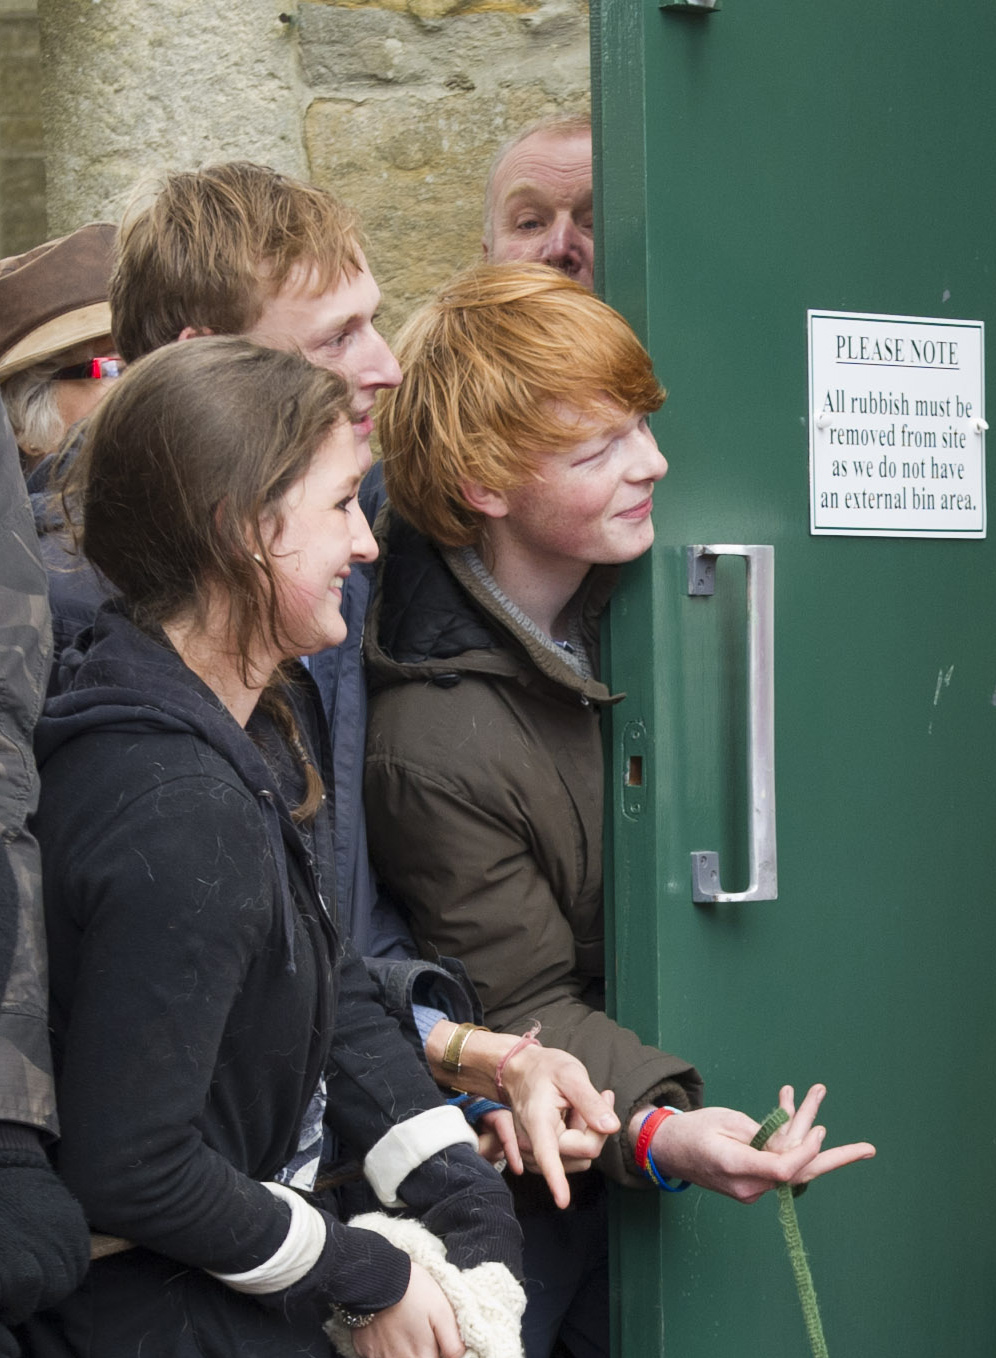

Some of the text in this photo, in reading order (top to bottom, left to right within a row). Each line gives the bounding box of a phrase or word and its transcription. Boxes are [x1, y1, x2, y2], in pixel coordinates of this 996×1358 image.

[836, 335, 959, 365] PLEASE NOTE
[822, 389, 973, 418] All rubbish must be
[829, 424, 966, 449] removed from site
[832, 455, 965, 479] as we do not have
[820, 487, 977, 511] an external bin area.
